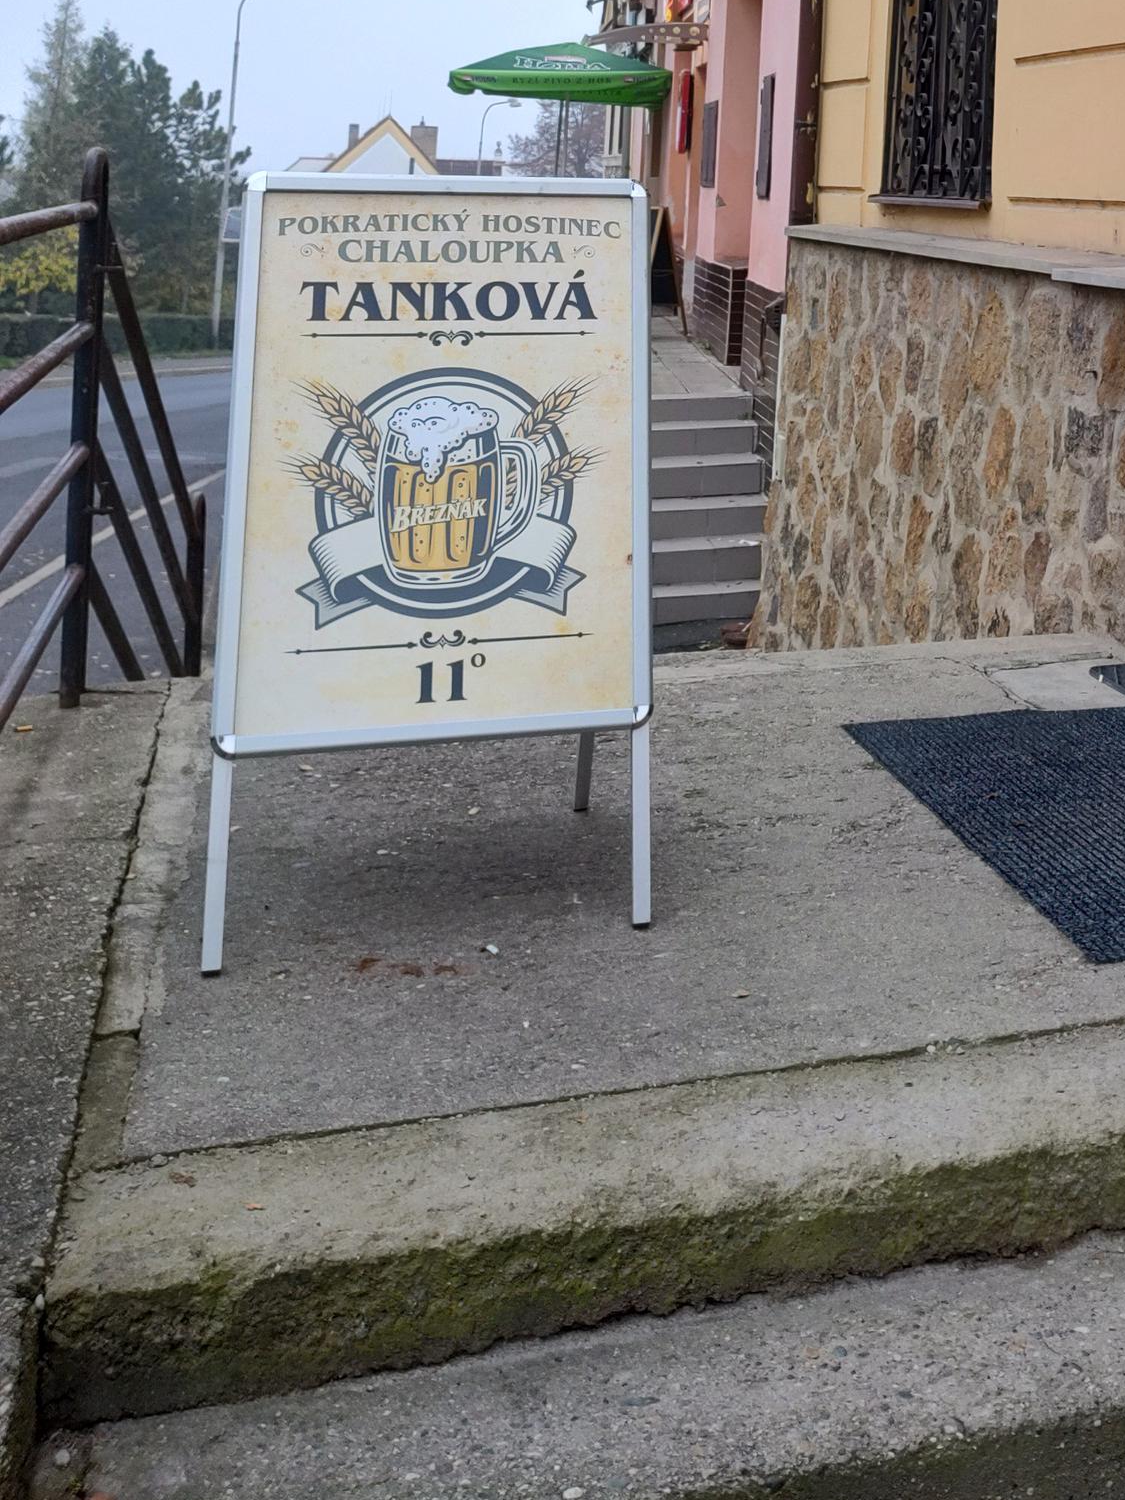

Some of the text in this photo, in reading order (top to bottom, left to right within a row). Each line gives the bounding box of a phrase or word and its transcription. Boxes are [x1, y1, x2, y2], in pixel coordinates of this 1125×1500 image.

[278, 209, 622, 239] POKRATICKÝ HOSTINEC
[337, 239, 565, 264] CHALOUPKA
[299, 269, 598, 322] TANKOVÁ
[390, 497, 487, 533] BŘEZŇÁK
